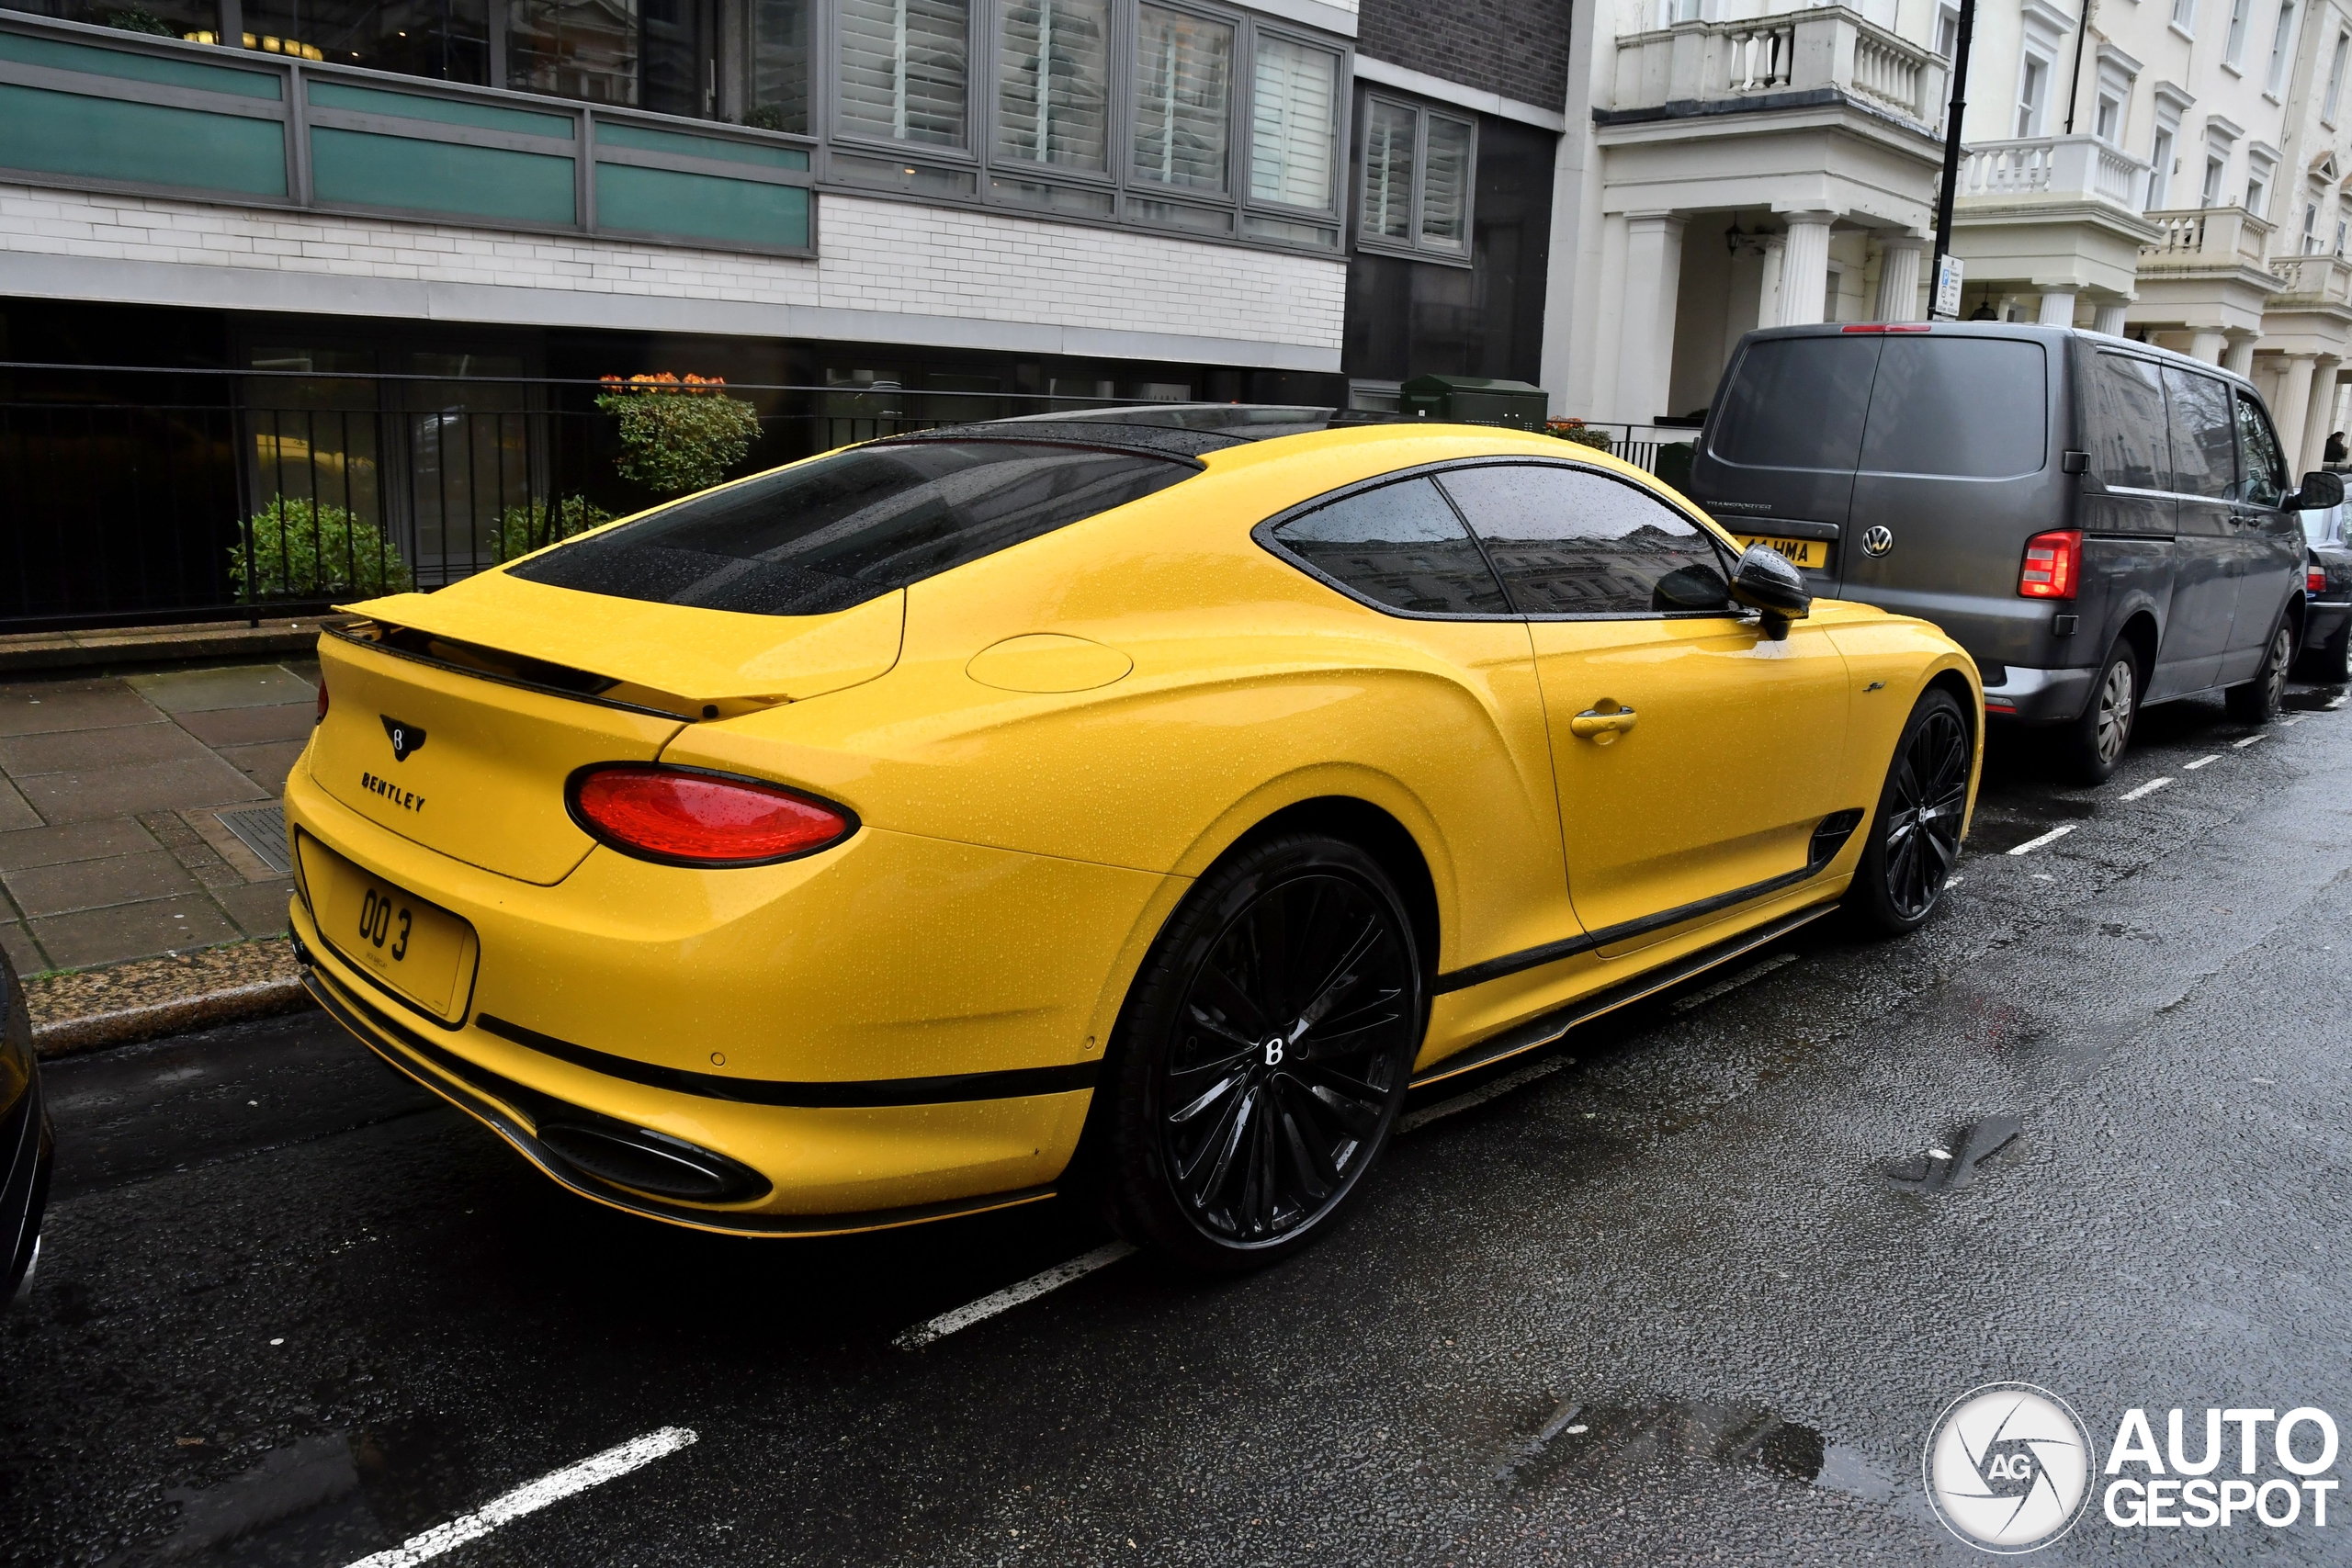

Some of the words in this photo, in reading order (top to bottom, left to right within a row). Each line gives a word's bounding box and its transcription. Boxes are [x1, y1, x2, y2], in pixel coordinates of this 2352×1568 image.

[1706, 501, 1772, 510] TRANSPORTER
[361, 772, 426, 813] BENTLEY
[1264, 1038, 1283, 1066] B
